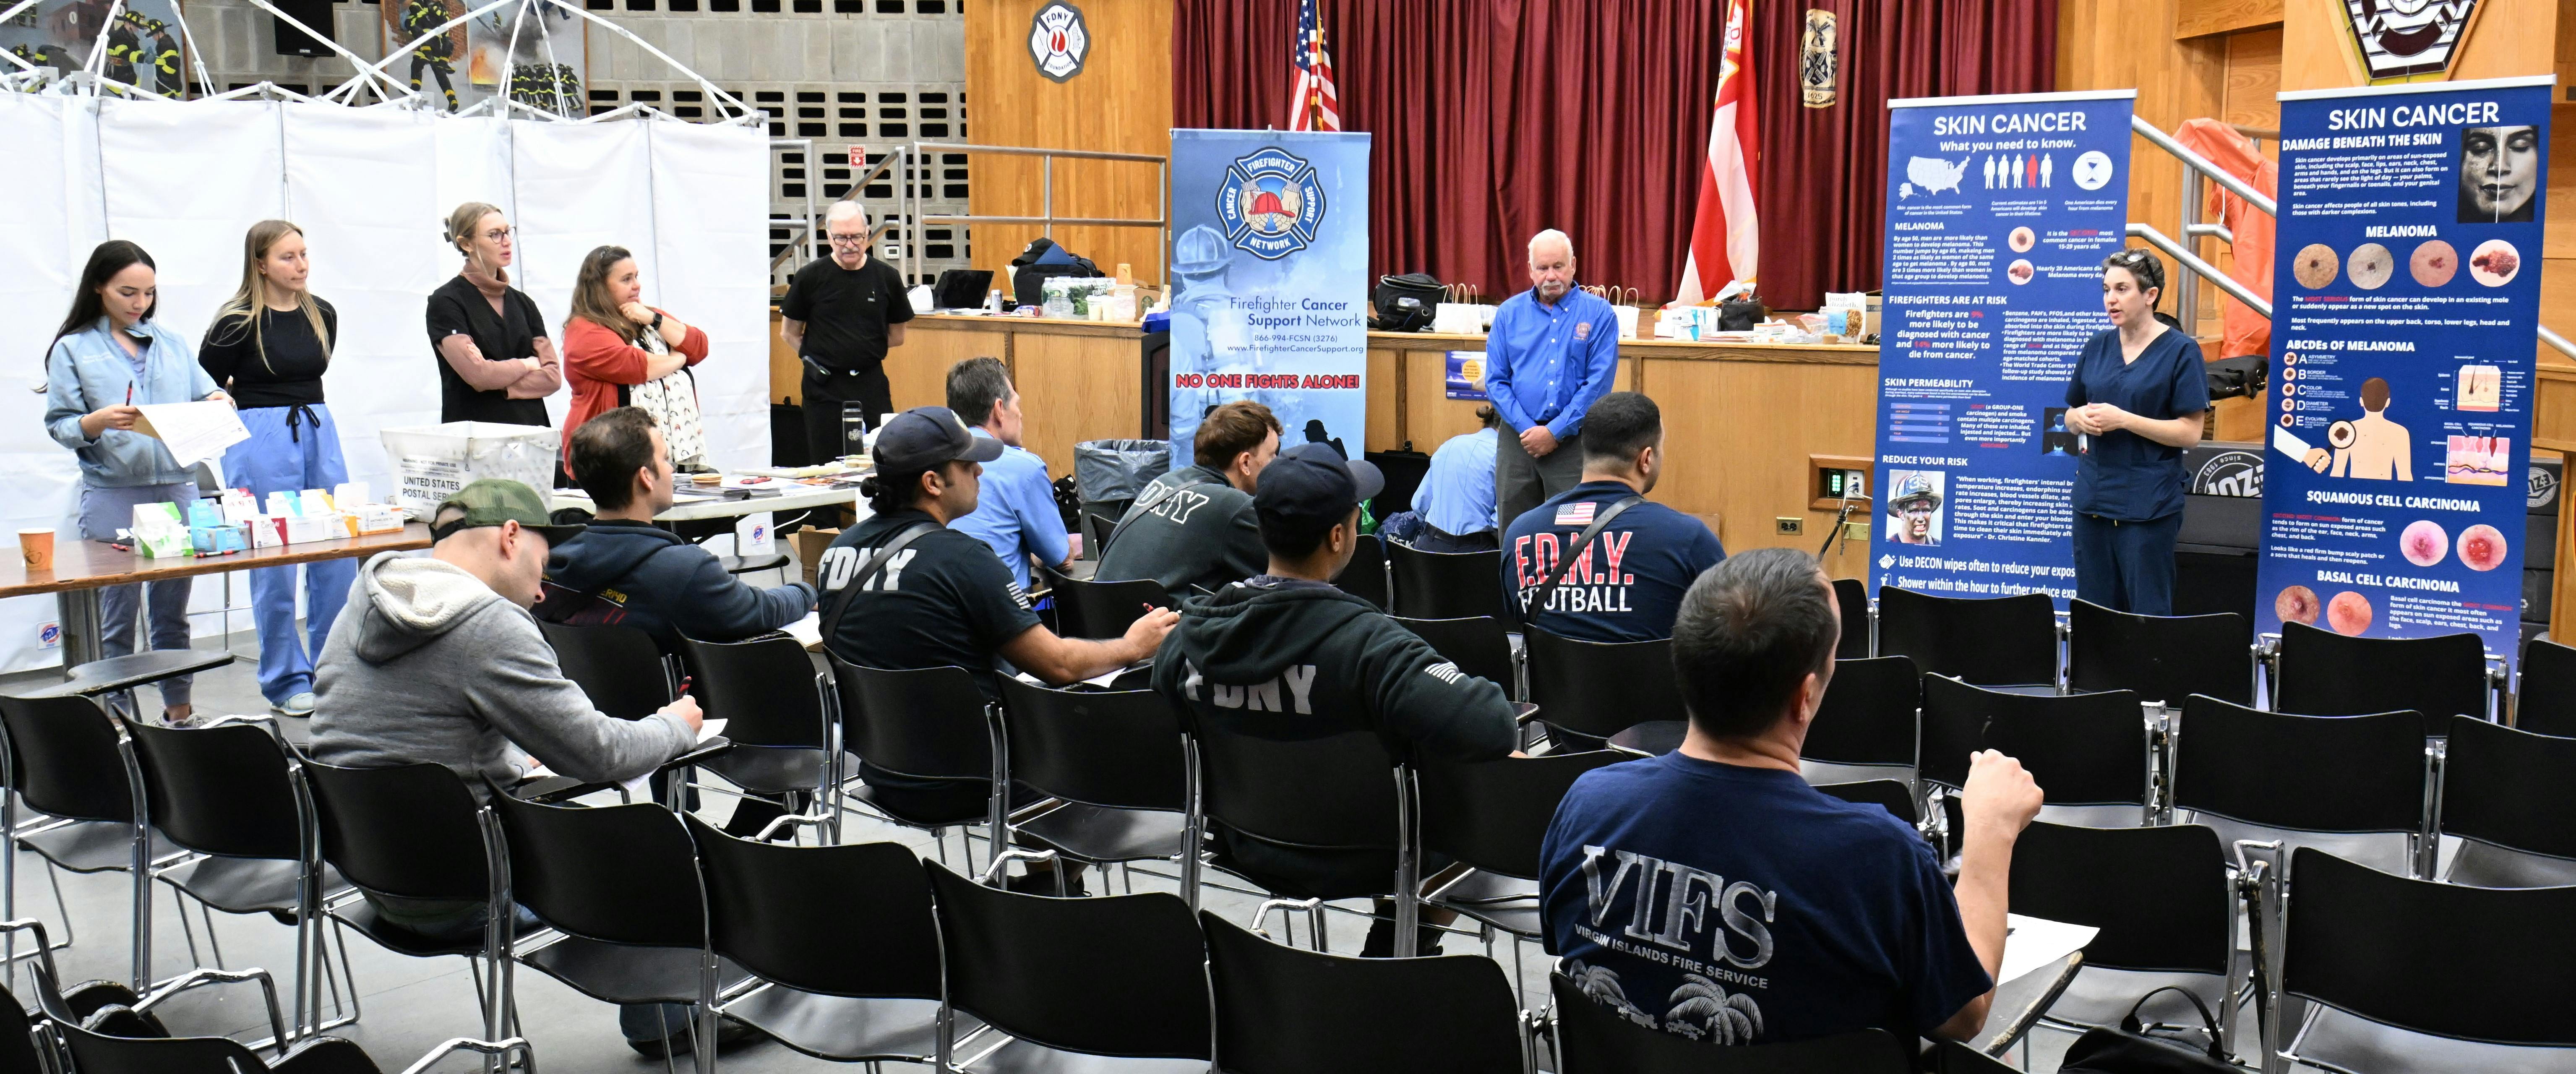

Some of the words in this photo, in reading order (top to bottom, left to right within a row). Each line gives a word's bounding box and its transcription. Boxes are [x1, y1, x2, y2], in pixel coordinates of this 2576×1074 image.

[1046, 12, 1068, 23] FDNY
[1048, 61, 1072, 70] FOUNDATION
[2328, 107, 2386, 130] SKIN
[2392, 102, 2499, 127] CANCER
[1934, 115, 1985, 136] SKIN
[1991, 112, 2086, 133] CANCER
[1940, 141, 1970, 151] What
[1972, 142, 1993, 153] you
[1996, 138, 2024, 150] need
[2026, 140, 2039, 149] to
[2041, 138, 2076, 149] know.
[2282, 138, 2331, 151] DAMAGE
[2333, 135, 2385, 149] BENEATH
[2388, 134, 2410, 146] THE
[2412, 133, 2442, 146] SKIN
[1247, 158, 1295, 173] FIREFIGHTER
[1226, 187, 1237, 220] CANCER
[1304, 186, 1316, 224] SUPPORT
[1895, 222, 1944, 230] MELANOMA
[2366, 225, 2437, 237] MELANOMA
[1250, 237, 1291, 250] NETWORK
[1231, 296, 1296, 313] Firefighter
[1301, 298, 1348, 310] Cancer
[1889, 295, 1950, 304] FIREFIGHTERS
[1952, 296, 1970, 305] ARE
[1972, 296, 1985, 305] AT
[1987, 296, 2007, 305] RISK
[1248, 313, 1301, 329] Support
[1306, 313, 1361, 326] Network
[1906, 310, 1953, 320] Firefighters
[1932, 320, 1955, 330] likely
[1897, 330, 1939, 340] diagnosed
[1227, 344, 1364, 354] www.FirefighterCancerSupport.org
[1956, 341, 1979, 350] likely
[2286, 340, 2328, 350] ABCDEs
[2330, 341, 2345, 350] OF
[2347, 341, 2415, 352] MELANOMA
[2298, 354, 2307, 364] A
[1176, 373, 1203, 388] NO
[1206, 374, 1242, 388] ONE
[1245, 374, 1299, 388] FIGHTS
[1301, 375, 1360, 389] ALONE!
[2298, 369, 2306, 380] B
[1885, 378, 1906, 386] SKIN
[1909, 378, 1973, 388] PERMEABILITY
[2297, 384, 2306, 395] C
[2297, 400, 2305, 410] D
[2296, 415, 2305, 426] E
[1882, 455, 1917, 464] REDUCE
[1919, 456, 1945, 465] YOUR
[1947, 457, 1968, 466] RISK
[2203, 462, 2219, 477] 1983
[404, 476, 430, 487] UNITED
[432, 479, 460, 490] STATES
[403, 488, 430, 500] POSTAL
[2307, 490, 2373, 505] SQUAMOUS
[2375, 495, 2402, 507] CELL
[2405, 496, 2480, 512] CARCINOMA
[818, 546, 917, 591] FDNY
[1899, 555, 1914, 568] Use
[1915, 556, 1942, 569] DECON
[1944, 558, 1967, 573] wipes
[1968, 559, 1989, 572] often
[1991, 562, 2000, 573] to
[2002, 561, 2029, 574] reduce
[2030, 566, 2050, 578] your
[2051, 567, 2075, 580] expos
[1898, 576, 1927, 589] Shower
[1928, 578, 1953, 590] within
[1955, 579, 1969, 592] the
[1970, 580, 1989, 593] hour
[1991, 583, 1999, 594] to
[2001, 582, 2030, 595] further
[2317, 570, 2353, 584] BASAL
[2356, 573, 2383, 586] CELL
[2386, 576, 2460, 593] CARCINOMA
[1185, 658, 1316, 714] FDNY
[1582, 844, 1777, 970] VIFS
[1575, 923, 1610, 948] VIRGIN
[1612, 938, 1669, 964] ISLANDS
[1672, 955, 1703, 973] FIRE
[1706, 965, 1769, 989] SERVICE
